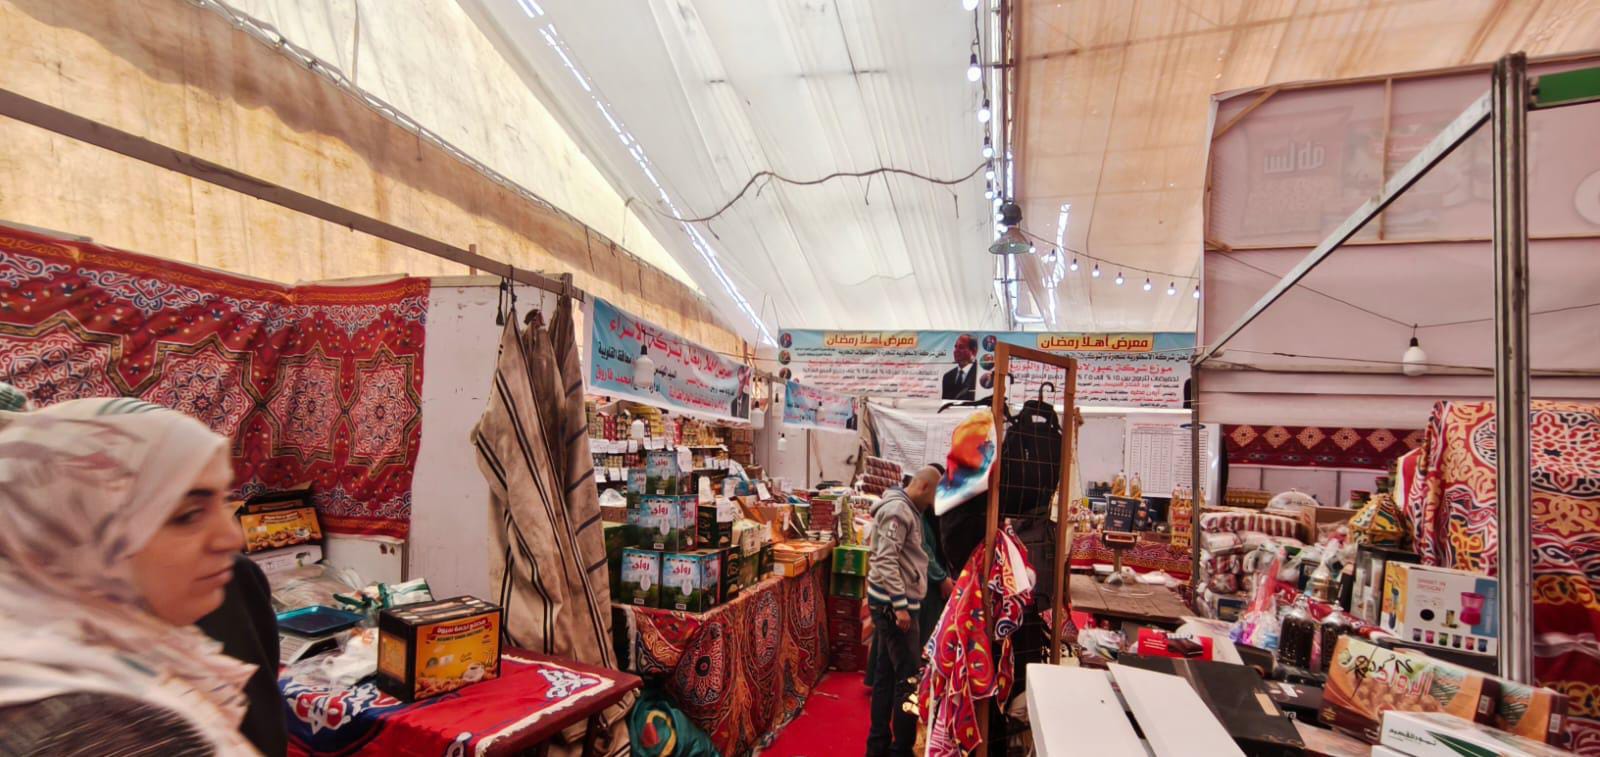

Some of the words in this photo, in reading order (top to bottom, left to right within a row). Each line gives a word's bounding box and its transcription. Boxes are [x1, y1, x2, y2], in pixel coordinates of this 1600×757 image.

[826, 334, 858, 347] رمضان
[882, 333, 914, 346] معرض
[1040, 335, 1079, 350] رمضان
[1111, 336, 1148, 350] معرض
[1115, 363, 1149, 374] شركة
